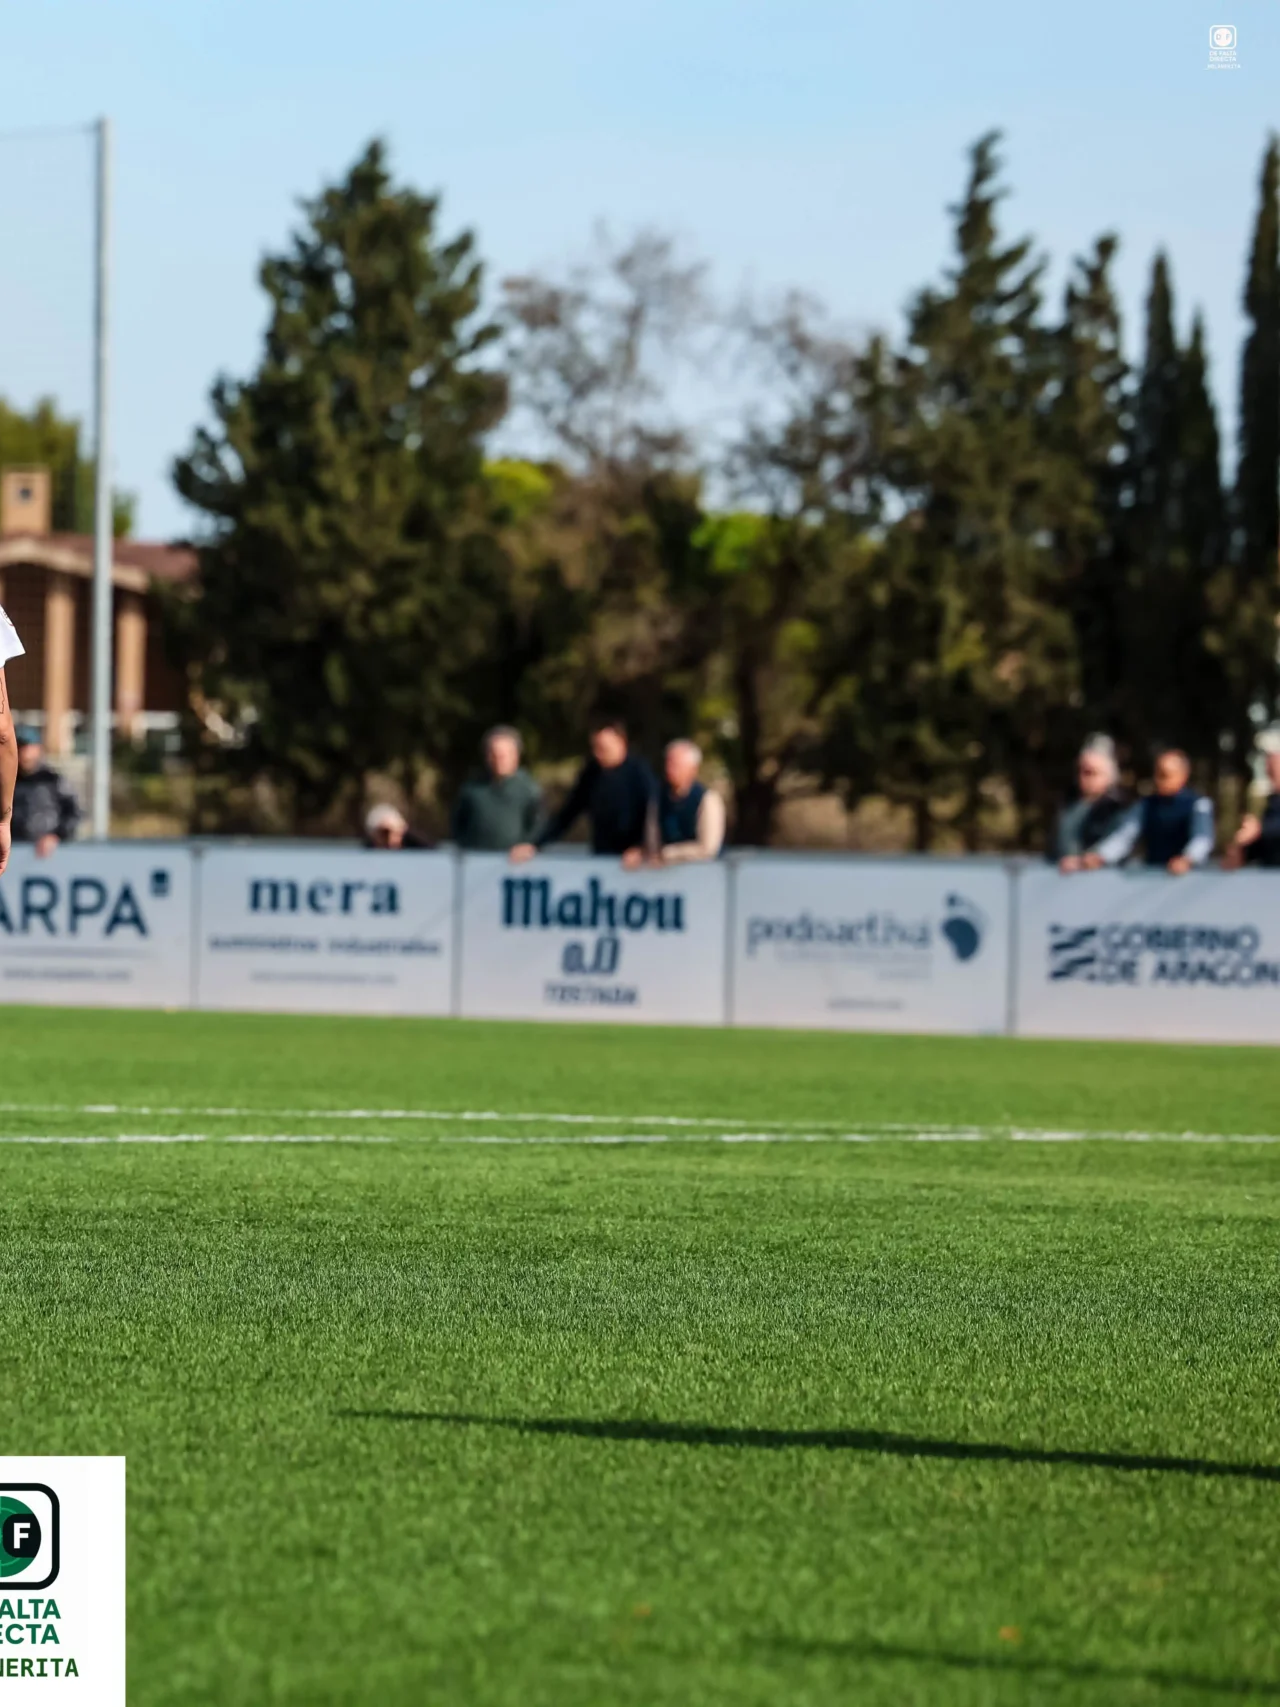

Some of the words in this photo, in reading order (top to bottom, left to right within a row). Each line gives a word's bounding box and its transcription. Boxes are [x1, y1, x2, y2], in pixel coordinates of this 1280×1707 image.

[248, 878, 401, 915] mera
[502, 874, 685, 931] Mahou
[1103, 924, 1260, 950] GOBIERNO
[1103, 959, 1139, 985] DE
